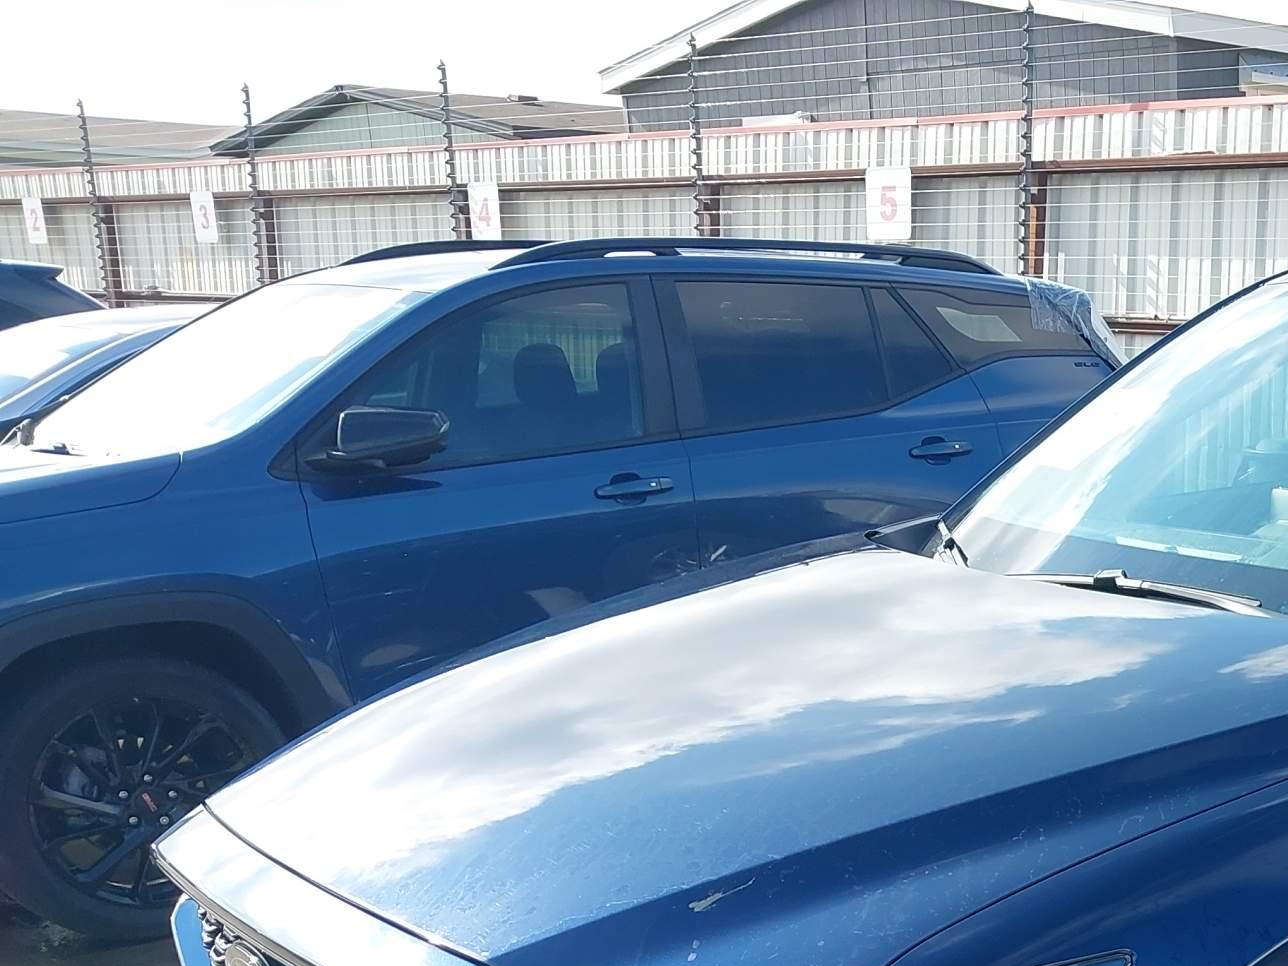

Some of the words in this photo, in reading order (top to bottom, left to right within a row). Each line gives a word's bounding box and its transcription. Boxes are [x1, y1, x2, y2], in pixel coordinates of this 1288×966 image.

[199, 204, 210, 230] 3
[478, 197, 492, 227] 4
[880, 186, 897, 222] 5
[29, 208, 41, 232] 2
